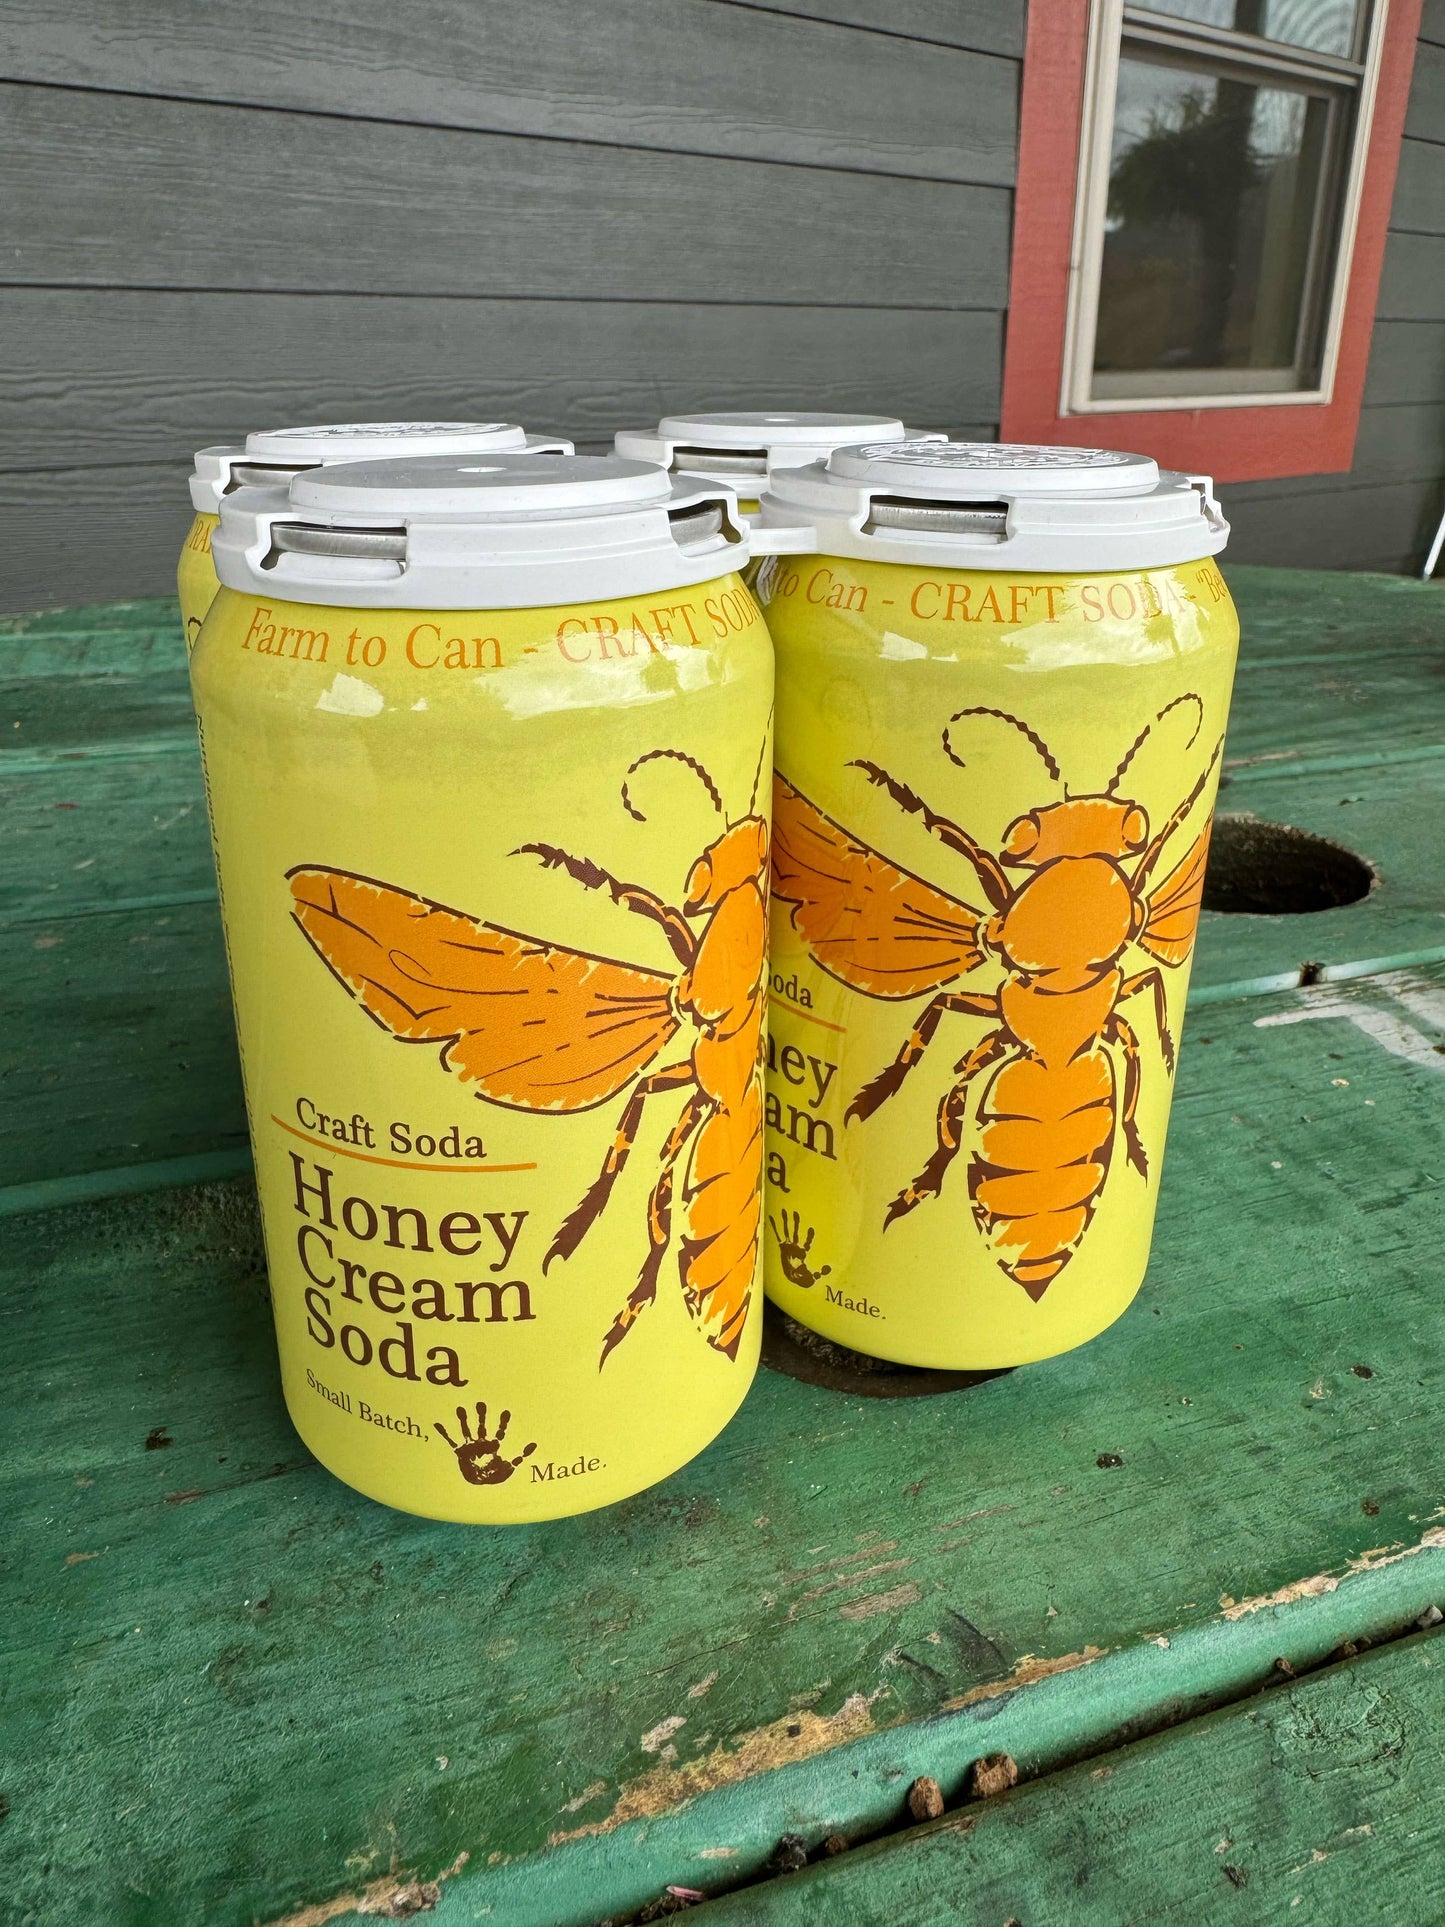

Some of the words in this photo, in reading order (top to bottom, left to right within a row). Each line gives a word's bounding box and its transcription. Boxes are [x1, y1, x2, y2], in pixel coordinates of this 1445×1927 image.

[241, 607, 330, 663] Farm
[346, 627, 387, 667] to
[406, 623, 504, 669] Can
[556, 604, 702, 663] CRAFT
[806, 568, 868, 612] Can
[910, 581, 1065, 623] CRAFT
[1080, 579, 1186, 623] SODA
[296, 1097, 376, 1149] Craft
[390, 1122, 487, 1158] Soda
[288, 1151, 529, 1272] Honey
[297, 1224, 536, 1323] Cream
[825, 1285, 886, 1320] Made.
[304, 1287, 469, 1387] Soda
[306, 1368, 353, 1414] Small
[358, 1400, 429, 1442] Batch,
[530, 1455, 607, 1483] Made.
